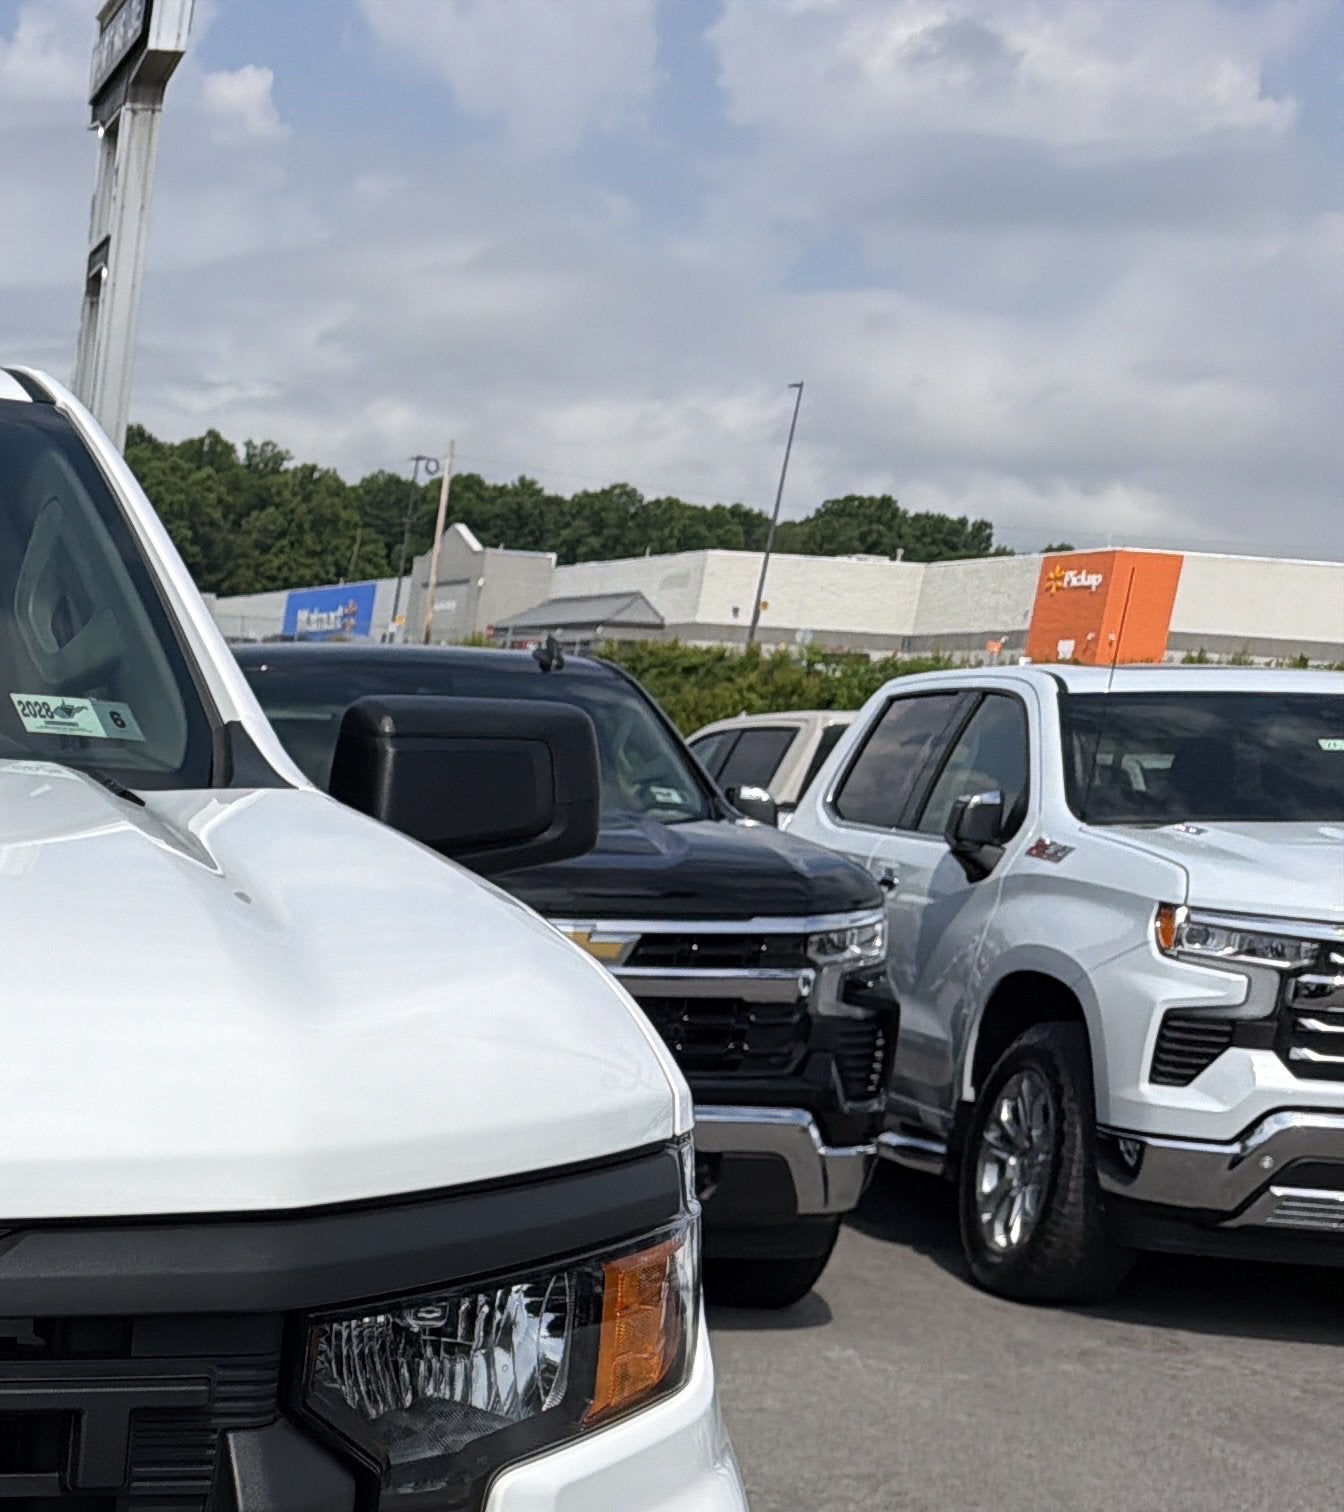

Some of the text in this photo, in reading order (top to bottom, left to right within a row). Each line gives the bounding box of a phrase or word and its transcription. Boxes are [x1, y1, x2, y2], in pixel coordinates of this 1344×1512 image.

[1063, 568, 1103, 592] Pickup
[16, 699, 55, 719] 2028
[109, 710, 127, 729] 6
